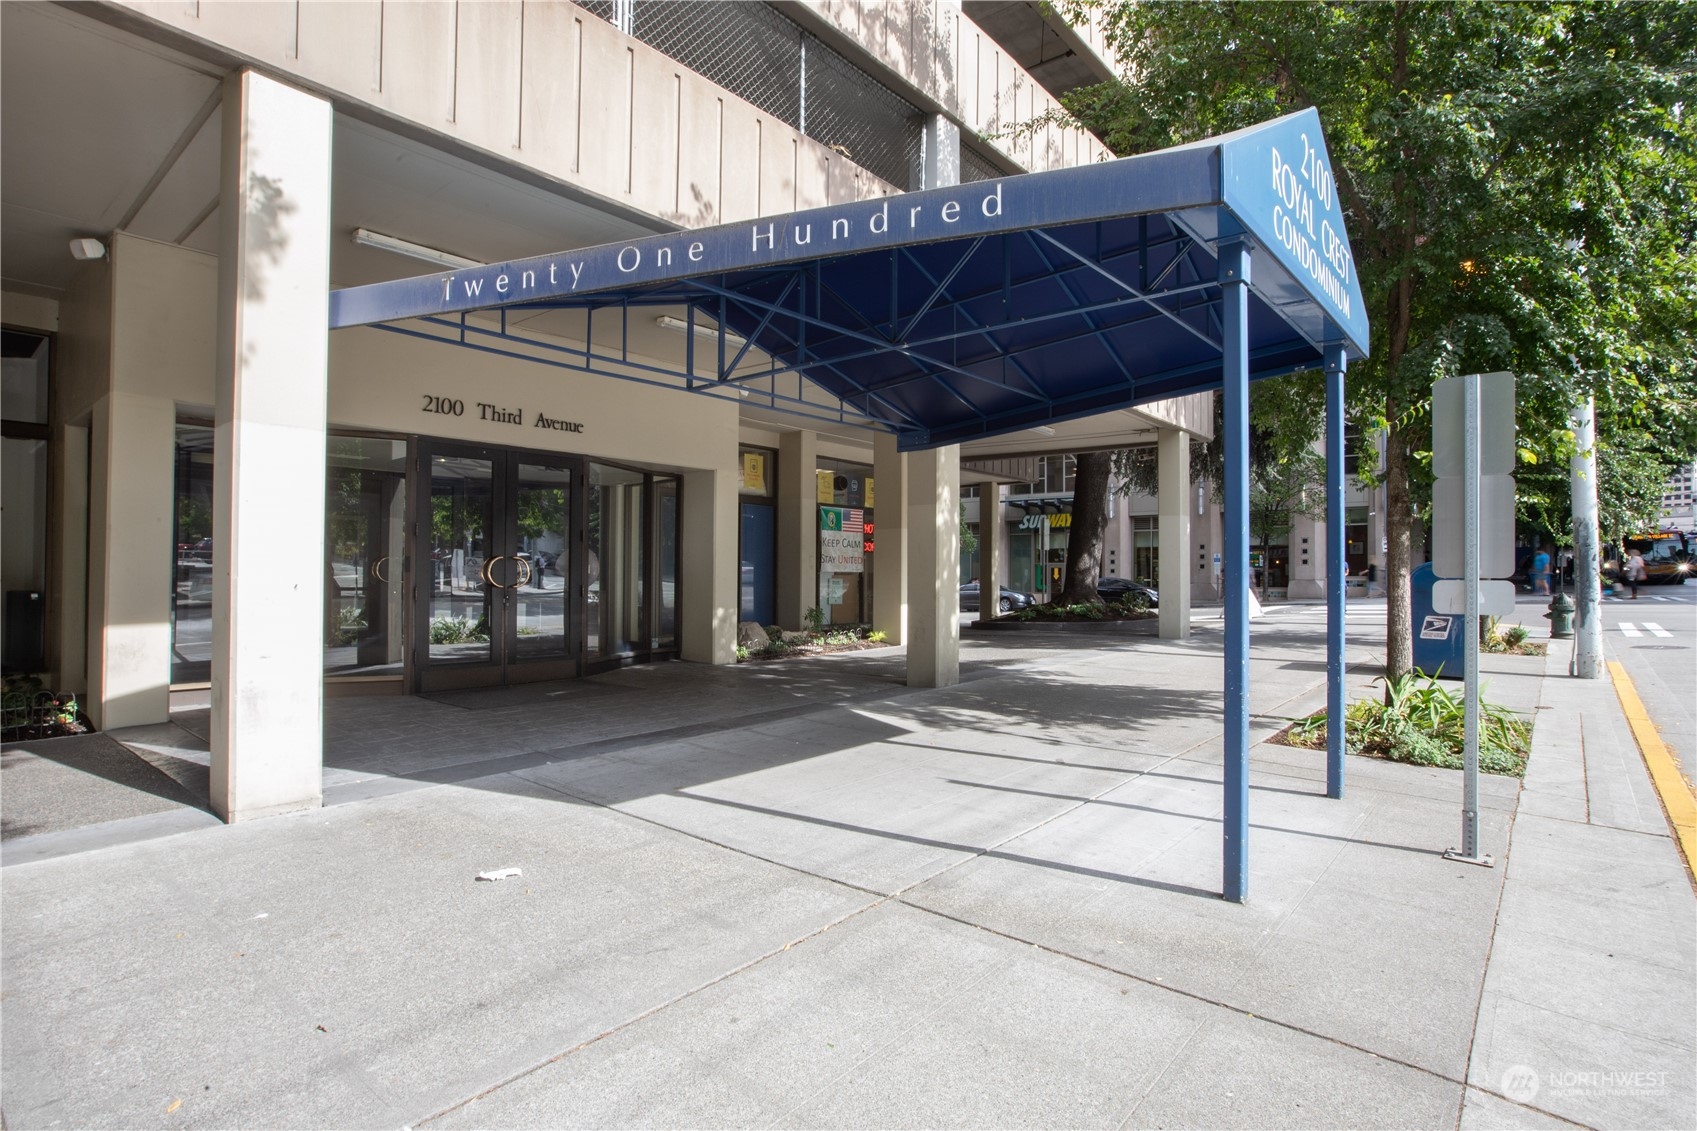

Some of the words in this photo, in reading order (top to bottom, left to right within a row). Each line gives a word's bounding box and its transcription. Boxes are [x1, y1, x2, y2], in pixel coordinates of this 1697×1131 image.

[1300, 132, 1332, 212] 2100
[441, 261, 584, 301] Twenty
[617, 241, 704, 273] One
[752, 183, 1002, 252] Hundred
[1272, 146, 1317, 241] ROYAL
[1321, 219, 1350, 284] CREST
[1273, 205, 1350, 319] CONDOMINIUM
[422, 394, 464, 417] 2100
[477, 402, 522, 426] Third
[534, 411, 585, 434] Avenue
[821, 554, 836, 564] STAY
[838, 555, 863, 564] UNITED
[822, 537, 840, 548] KEEP
[842, 538, 860, 548] CALM
